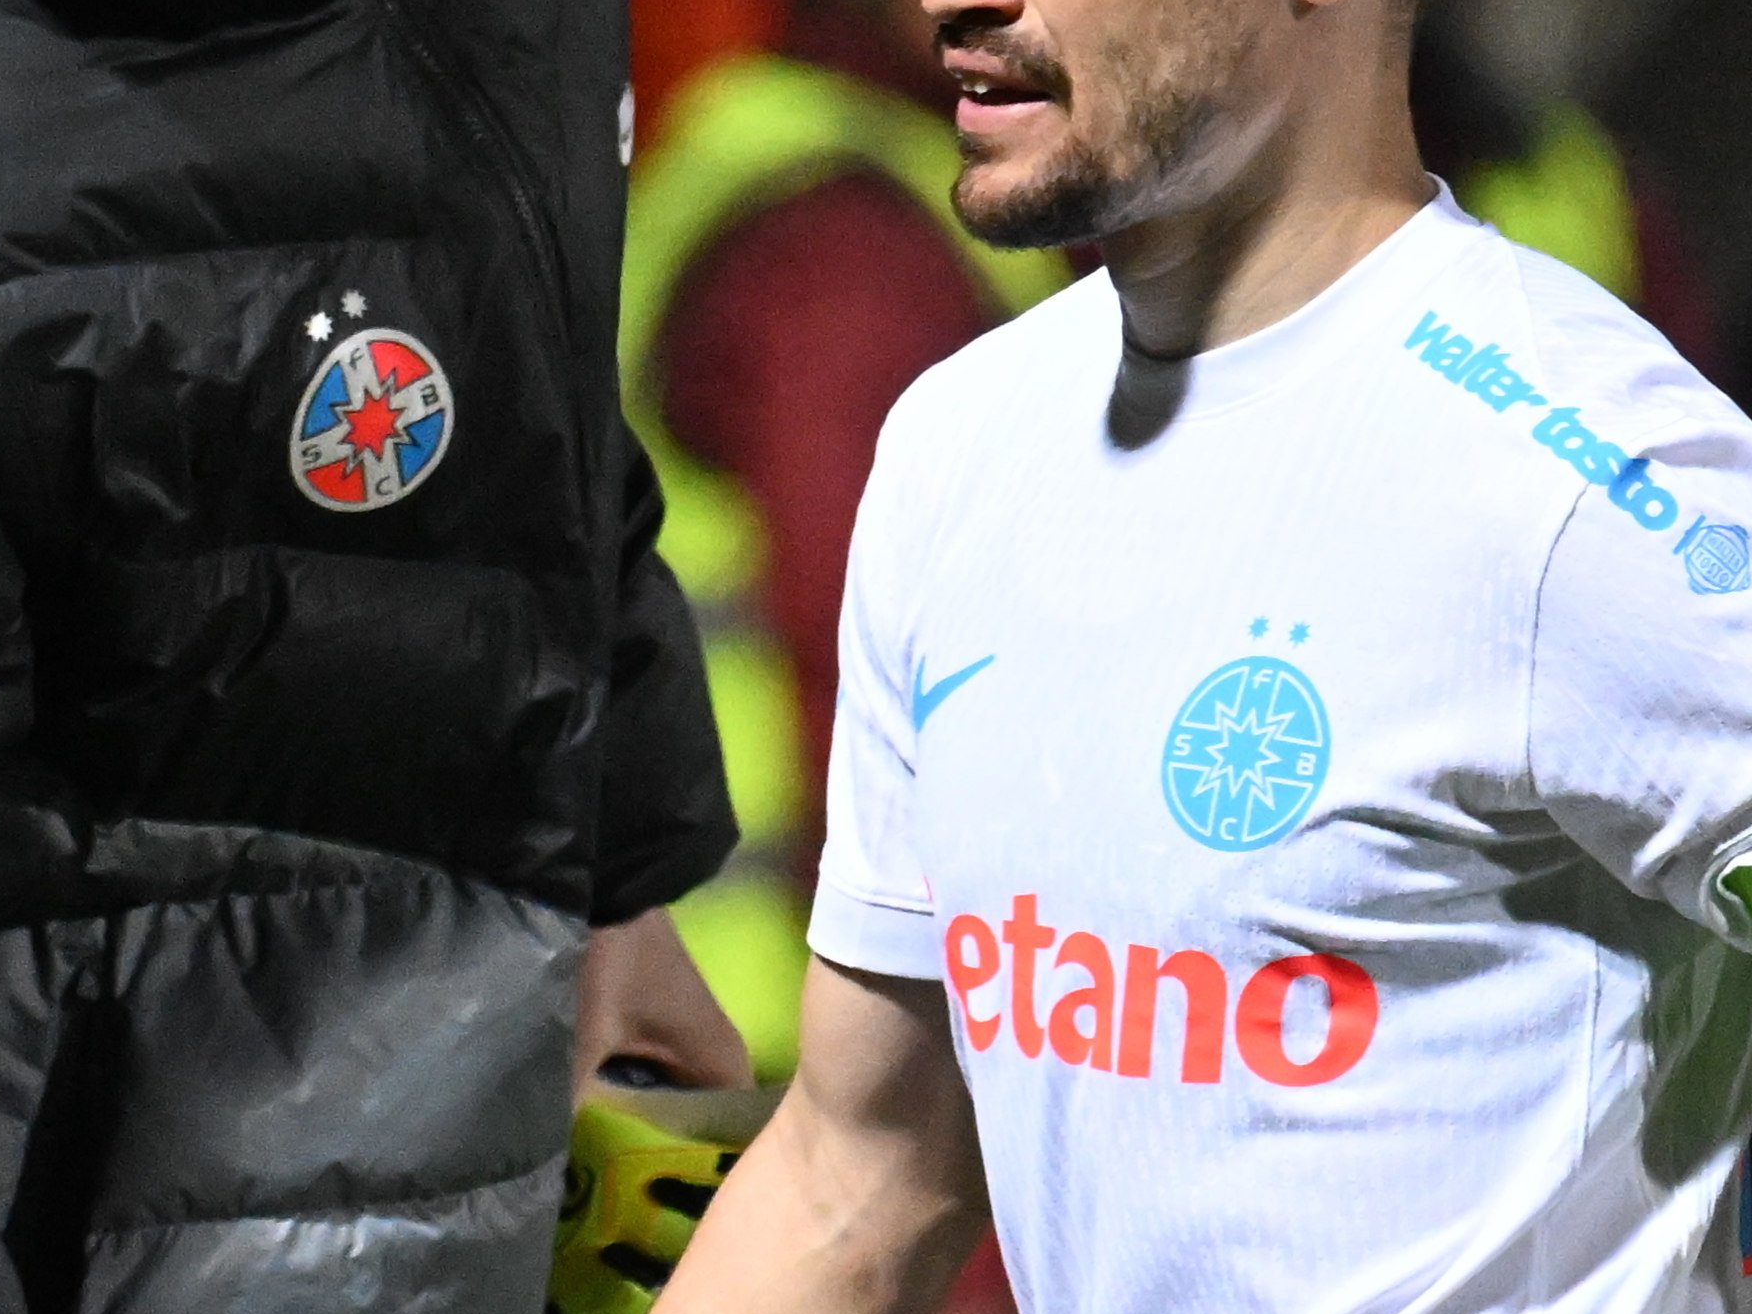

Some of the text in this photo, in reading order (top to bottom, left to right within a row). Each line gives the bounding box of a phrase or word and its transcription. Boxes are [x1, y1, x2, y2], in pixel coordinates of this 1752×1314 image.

[1404, 311, 1678, 531] walter tosto
[1253, 669, 1274, 689] F
[1172, 734, 1193, 756] S
[1219, 817, 1238, 841] C
[944, 893, 1379, 1087] etano
